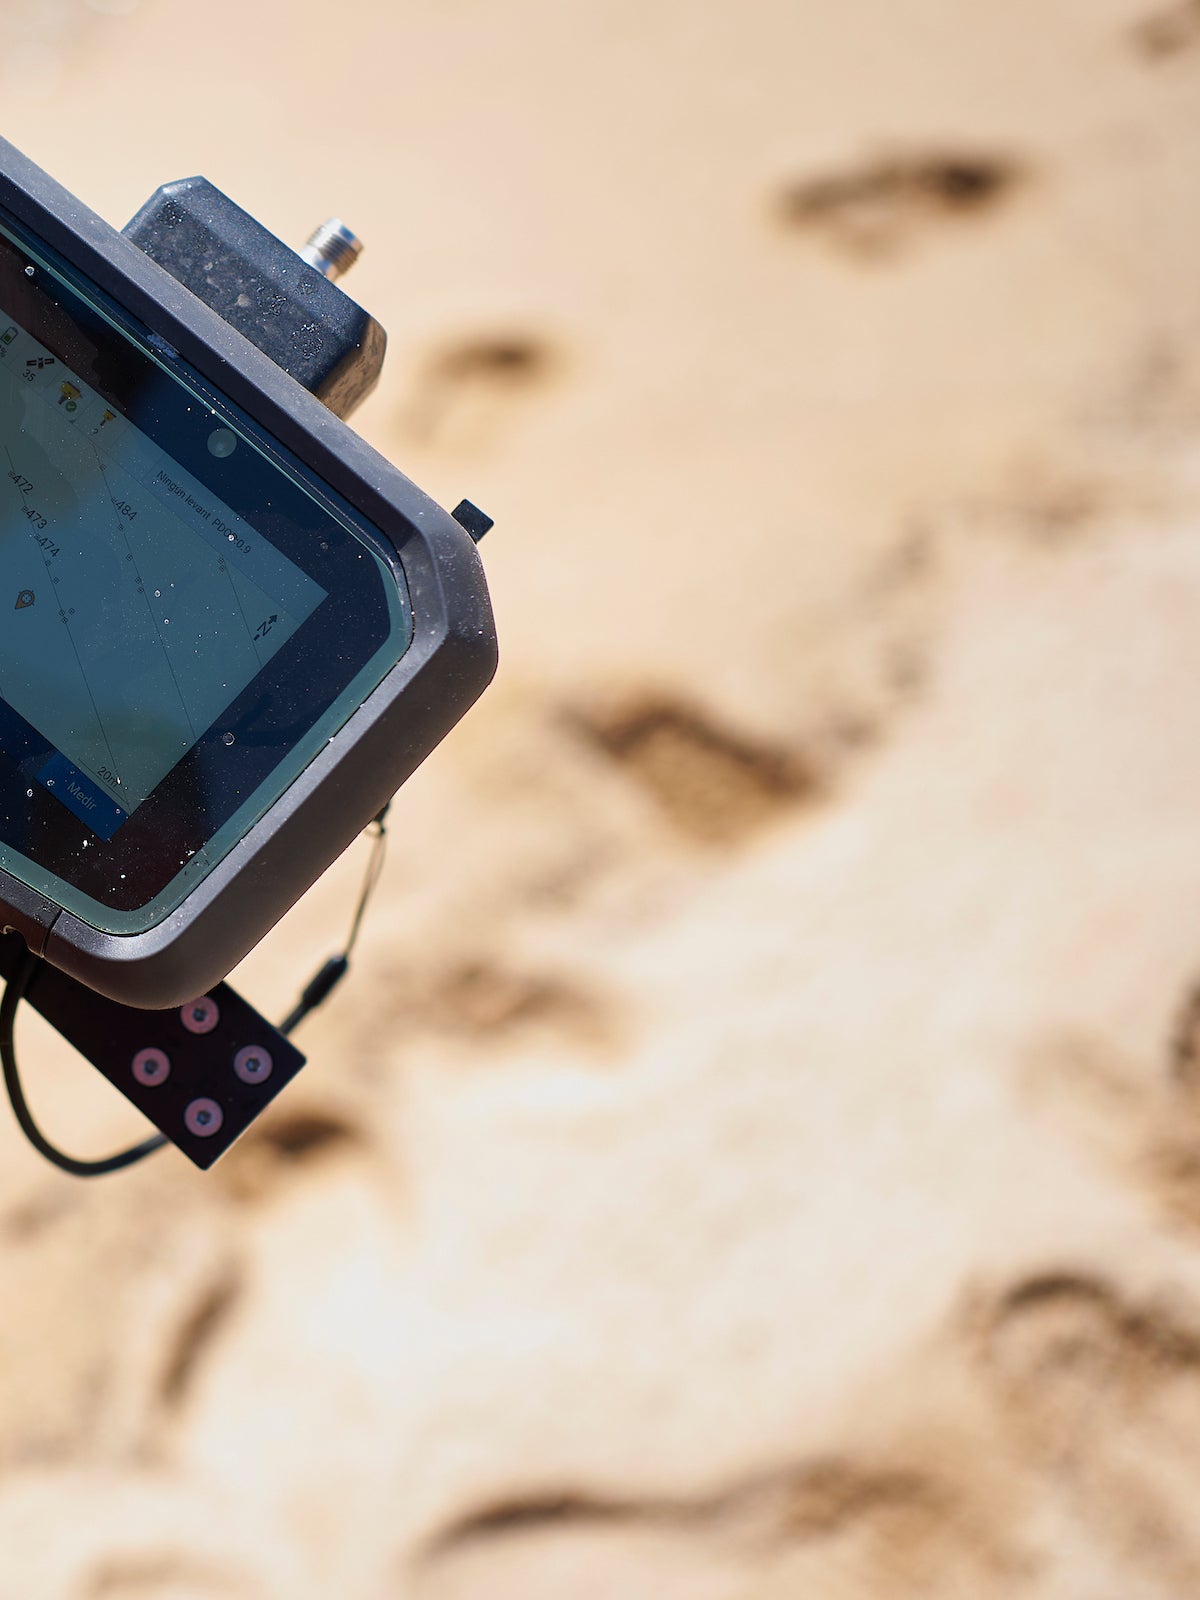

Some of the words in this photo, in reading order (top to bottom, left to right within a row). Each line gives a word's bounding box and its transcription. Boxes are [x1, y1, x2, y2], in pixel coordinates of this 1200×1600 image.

[21, 368, 37, 383] 35
[13, 472, 34, 496] 472
[26, 507, 48, 530] 473
[116, 499, 138, 522] 484
[38, 535, 61, 558] 474
[67, 781, 98, 811] Medir
